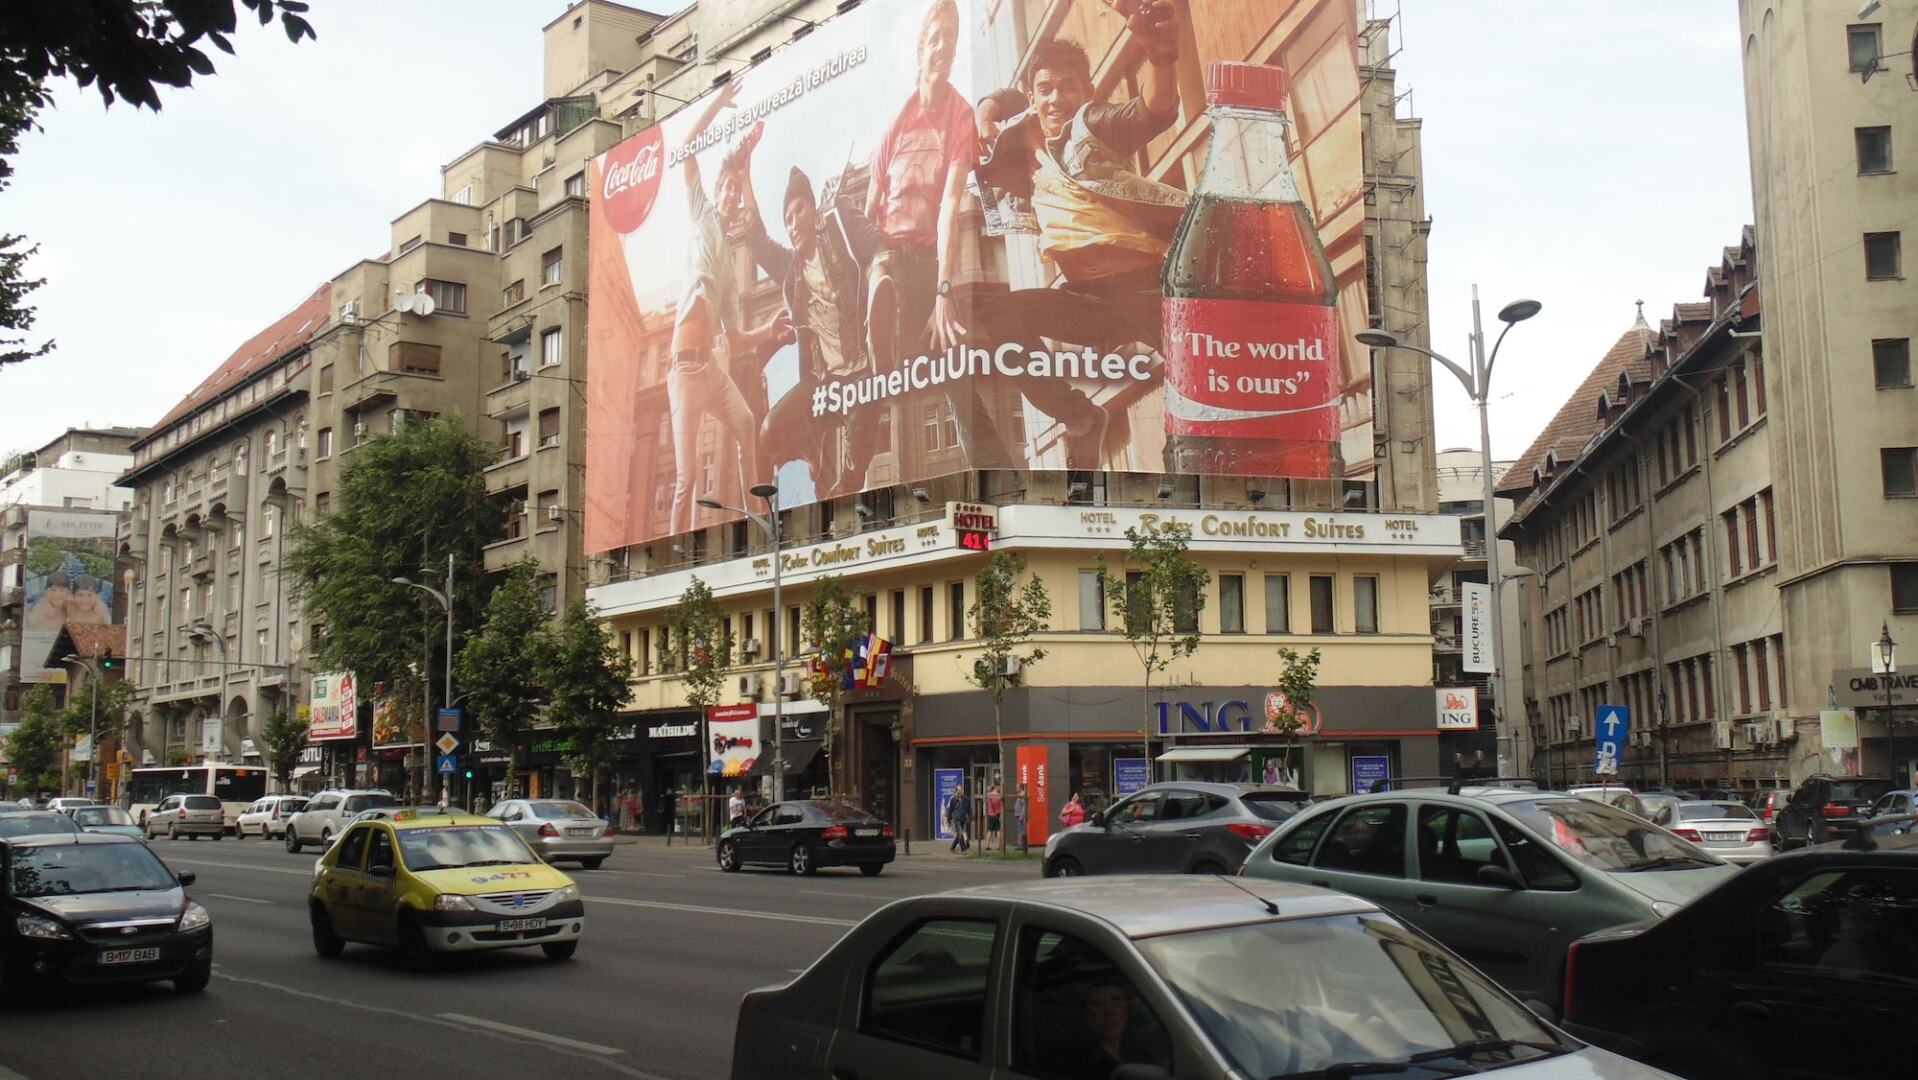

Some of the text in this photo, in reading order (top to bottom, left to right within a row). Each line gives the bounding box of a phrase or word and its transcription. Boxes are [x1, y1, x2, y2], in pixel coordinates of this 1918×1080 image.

[668, 124, 722, 168] Deschide
[738, 75, 804, 127] savurează
[807, 46, 867, 91] fericirea
[604, 139, 662, 199] Coca-Cola
[1247, 338, 1326, 361] world
[812, 342, 1151, 417] #SpuneiCuUnCantec
[1208, 368, 1230, 392] is
[954, 512, 997, 530] HOTEL
[1080, 512, 1117, 524] HOTEL
[1385, 519, 1419, 531] HOTEL
[917, 525, 940, 538] HOTEL
[1850, 677, 1878, 691] CMB
[1154, 701, 1252, 733] ING
[1442, 713, 1471, 724] ING
[472, 872, 532, 884] 9477
[134, 949, 155, 960] BAB
